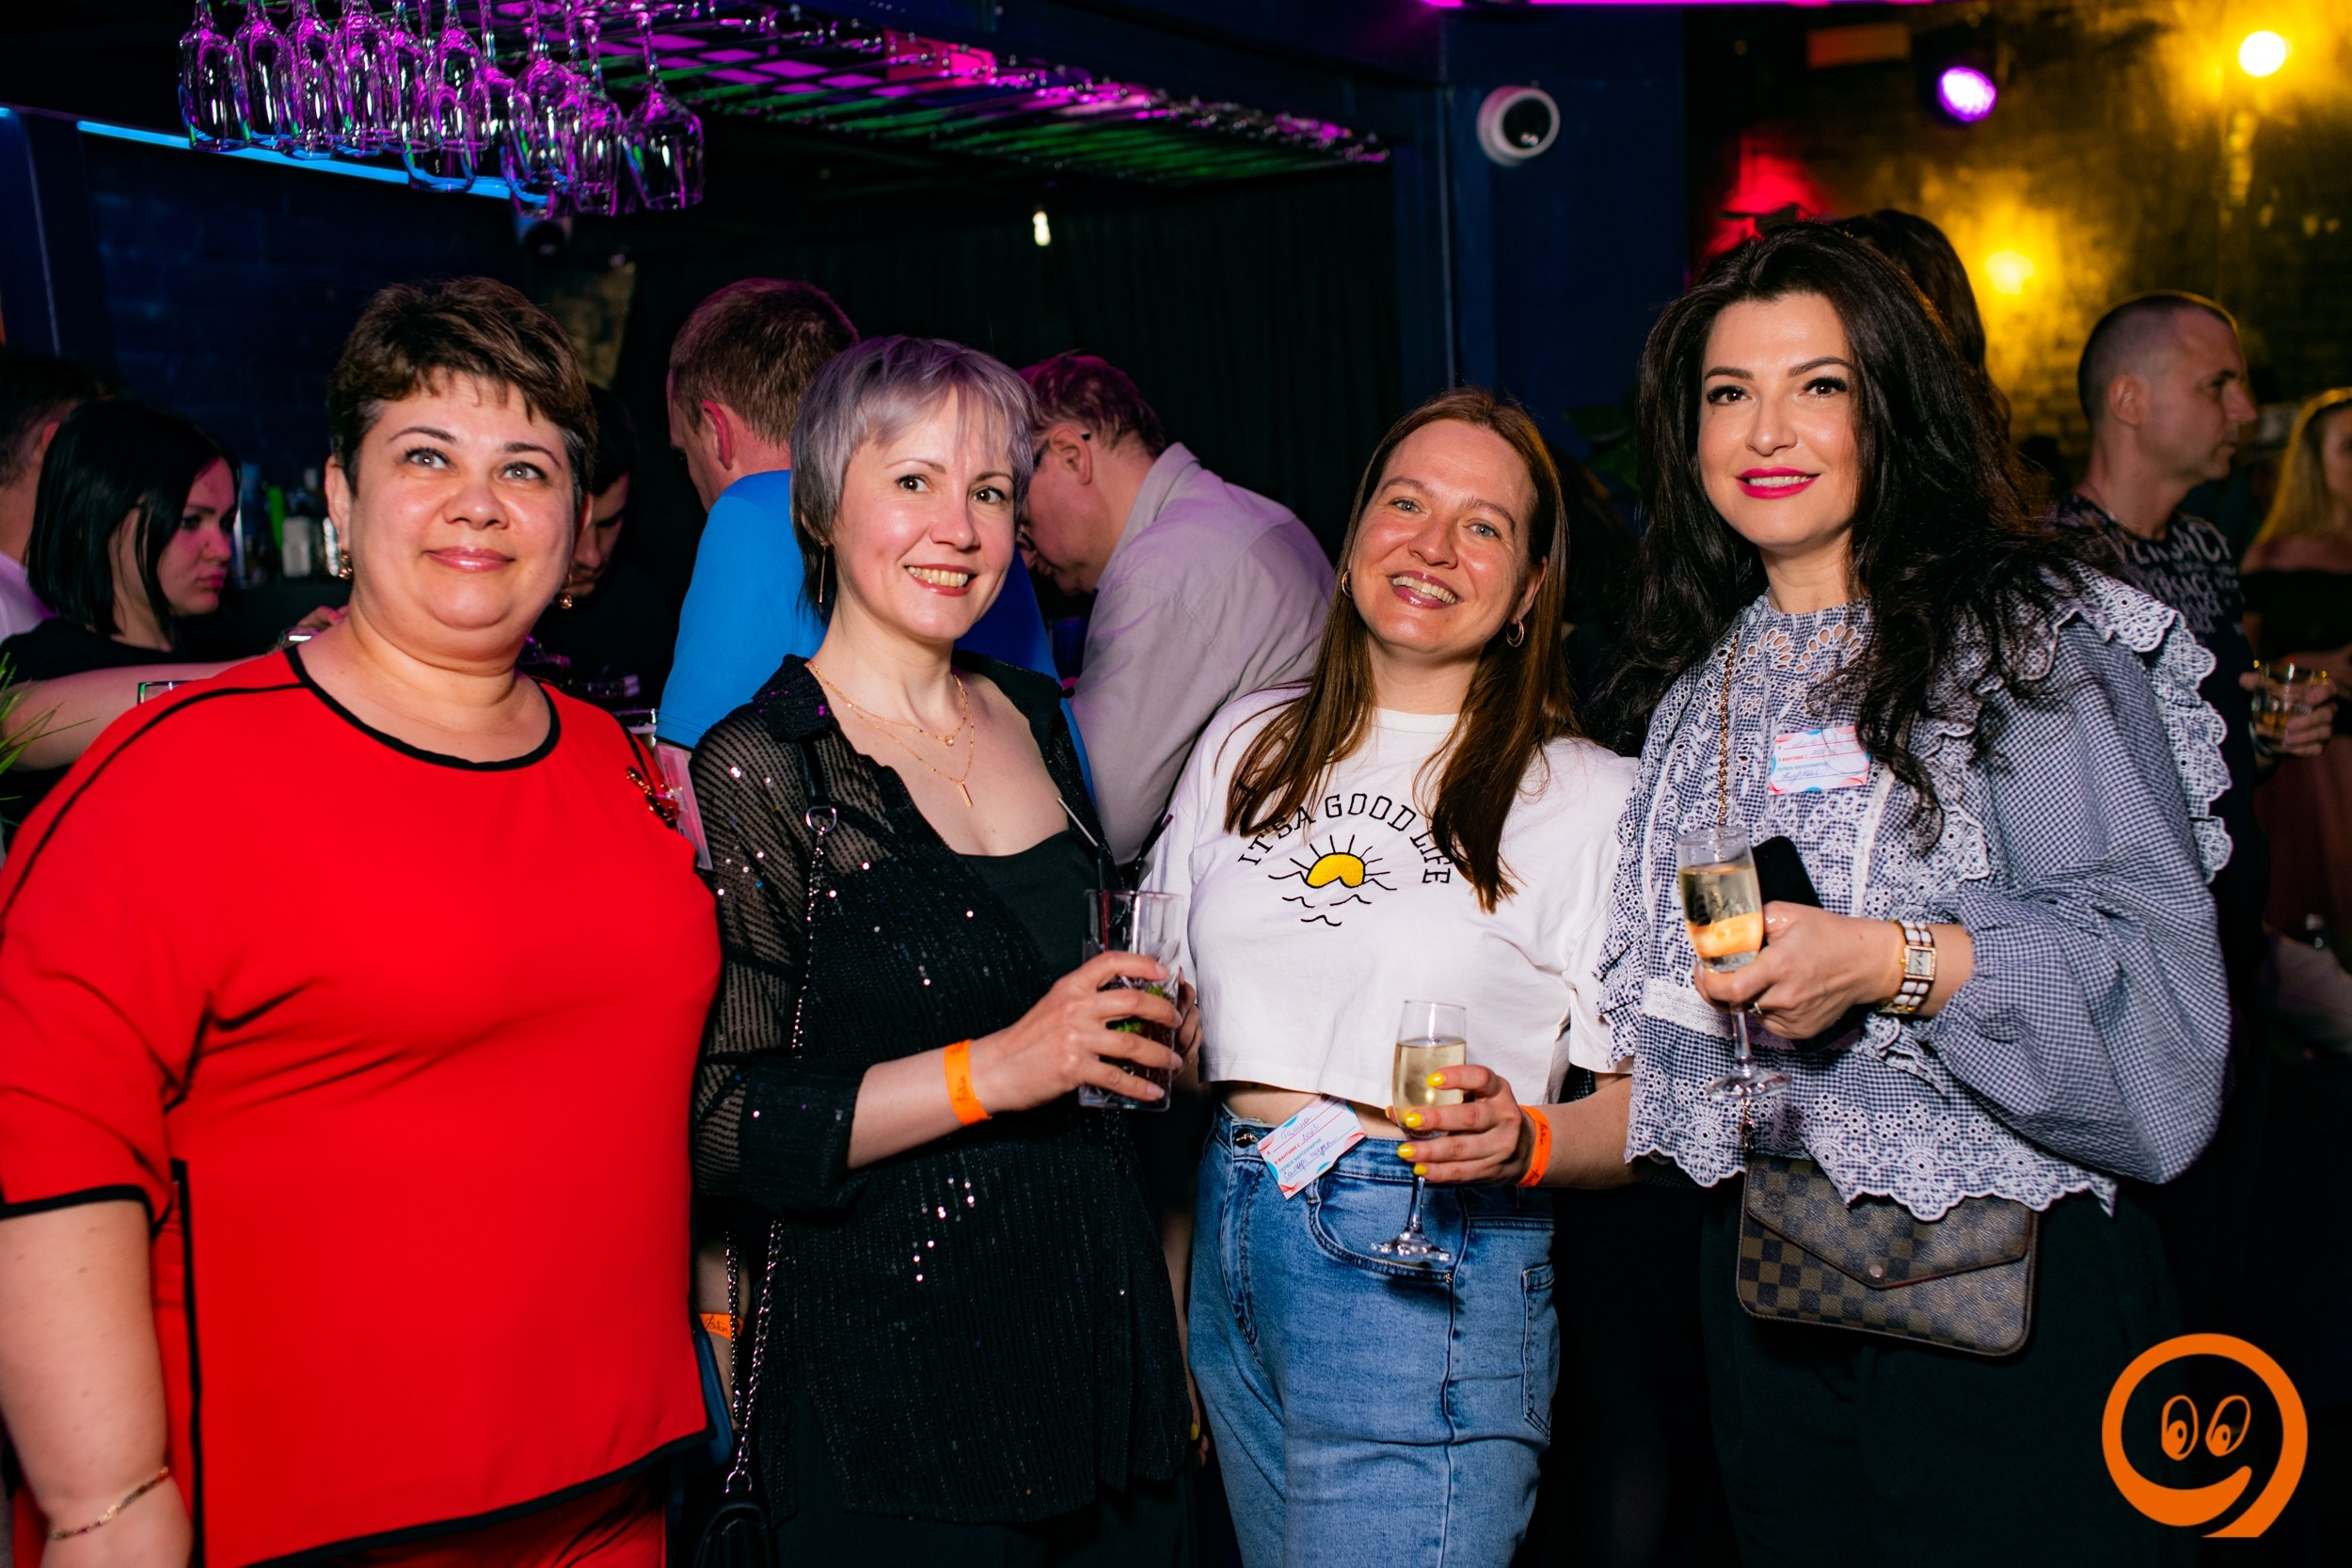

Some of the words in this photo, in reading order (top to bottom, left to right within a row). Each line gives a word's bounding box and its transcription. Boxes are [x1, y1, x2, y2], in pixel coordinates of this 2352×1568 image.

[1294, 806, 1316, 831] A
[1325, 793, 1417, 832] GOOD
[1409, 825, 1454, 883] LIFE
